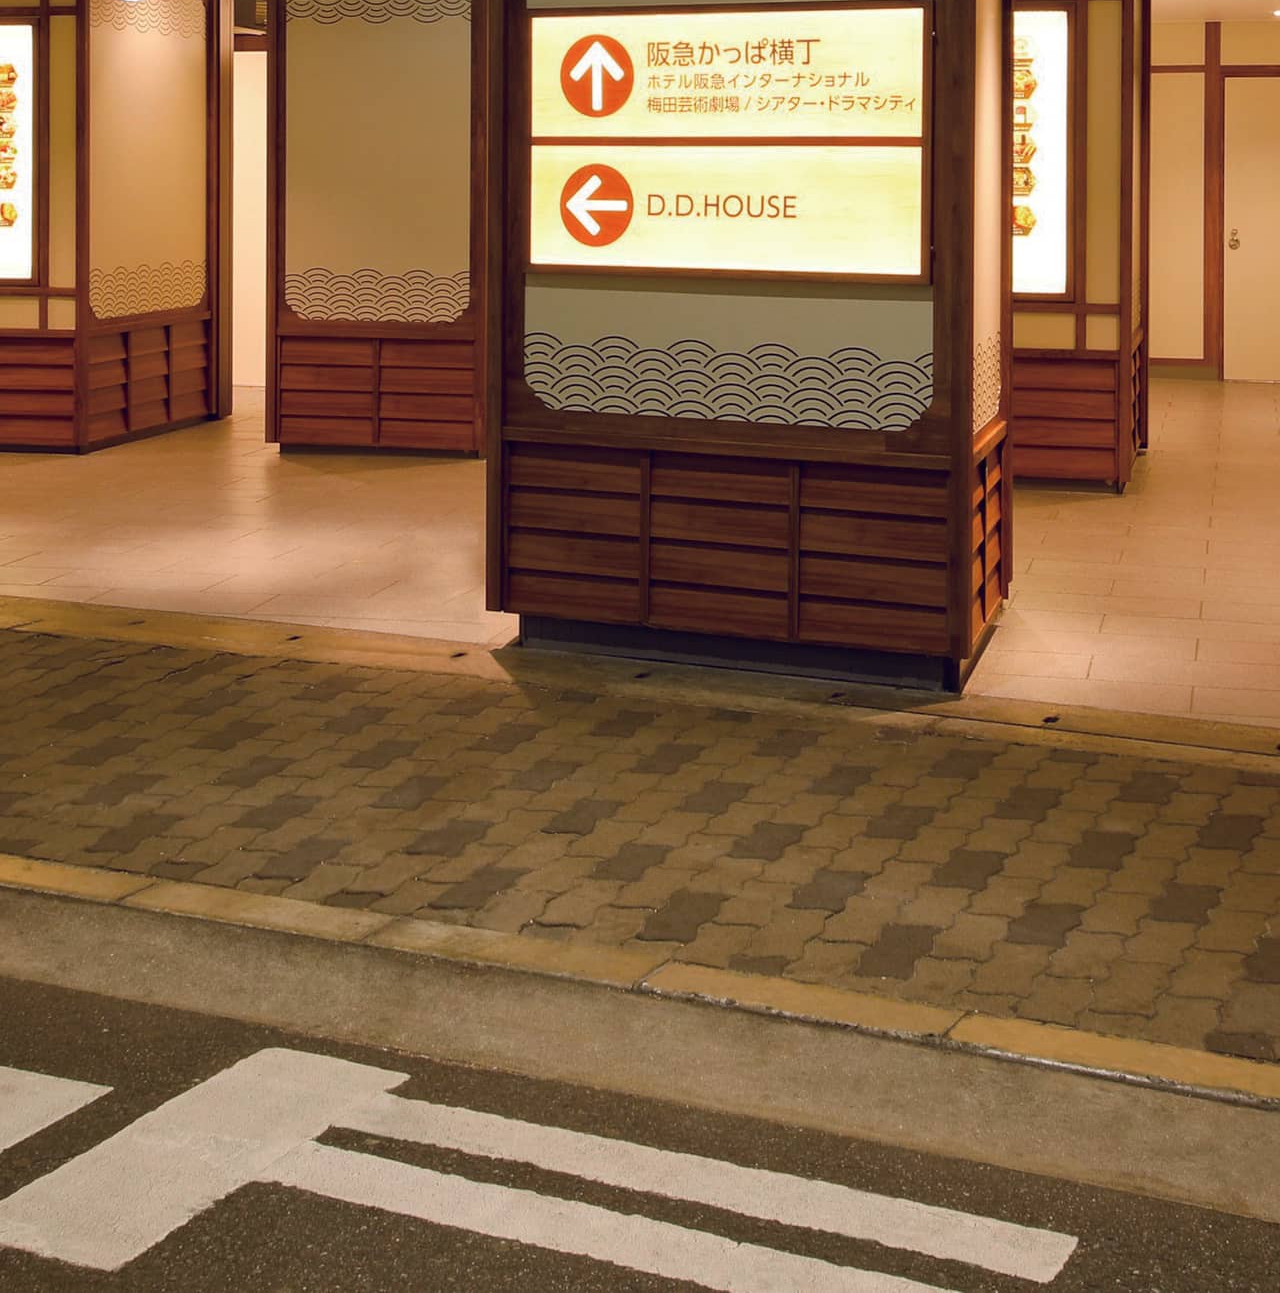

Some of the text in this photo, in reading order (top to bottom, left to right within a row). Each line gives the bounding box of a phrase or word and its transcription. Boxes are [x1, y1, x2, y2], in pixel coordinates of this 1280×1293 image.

[646, 37, 822, 68] 阪急かっぱ横丁
[646, 71, 871, 91] ホテル阪急インターナショナル
[646, 193, 798, 219] D.D.HOUSE
